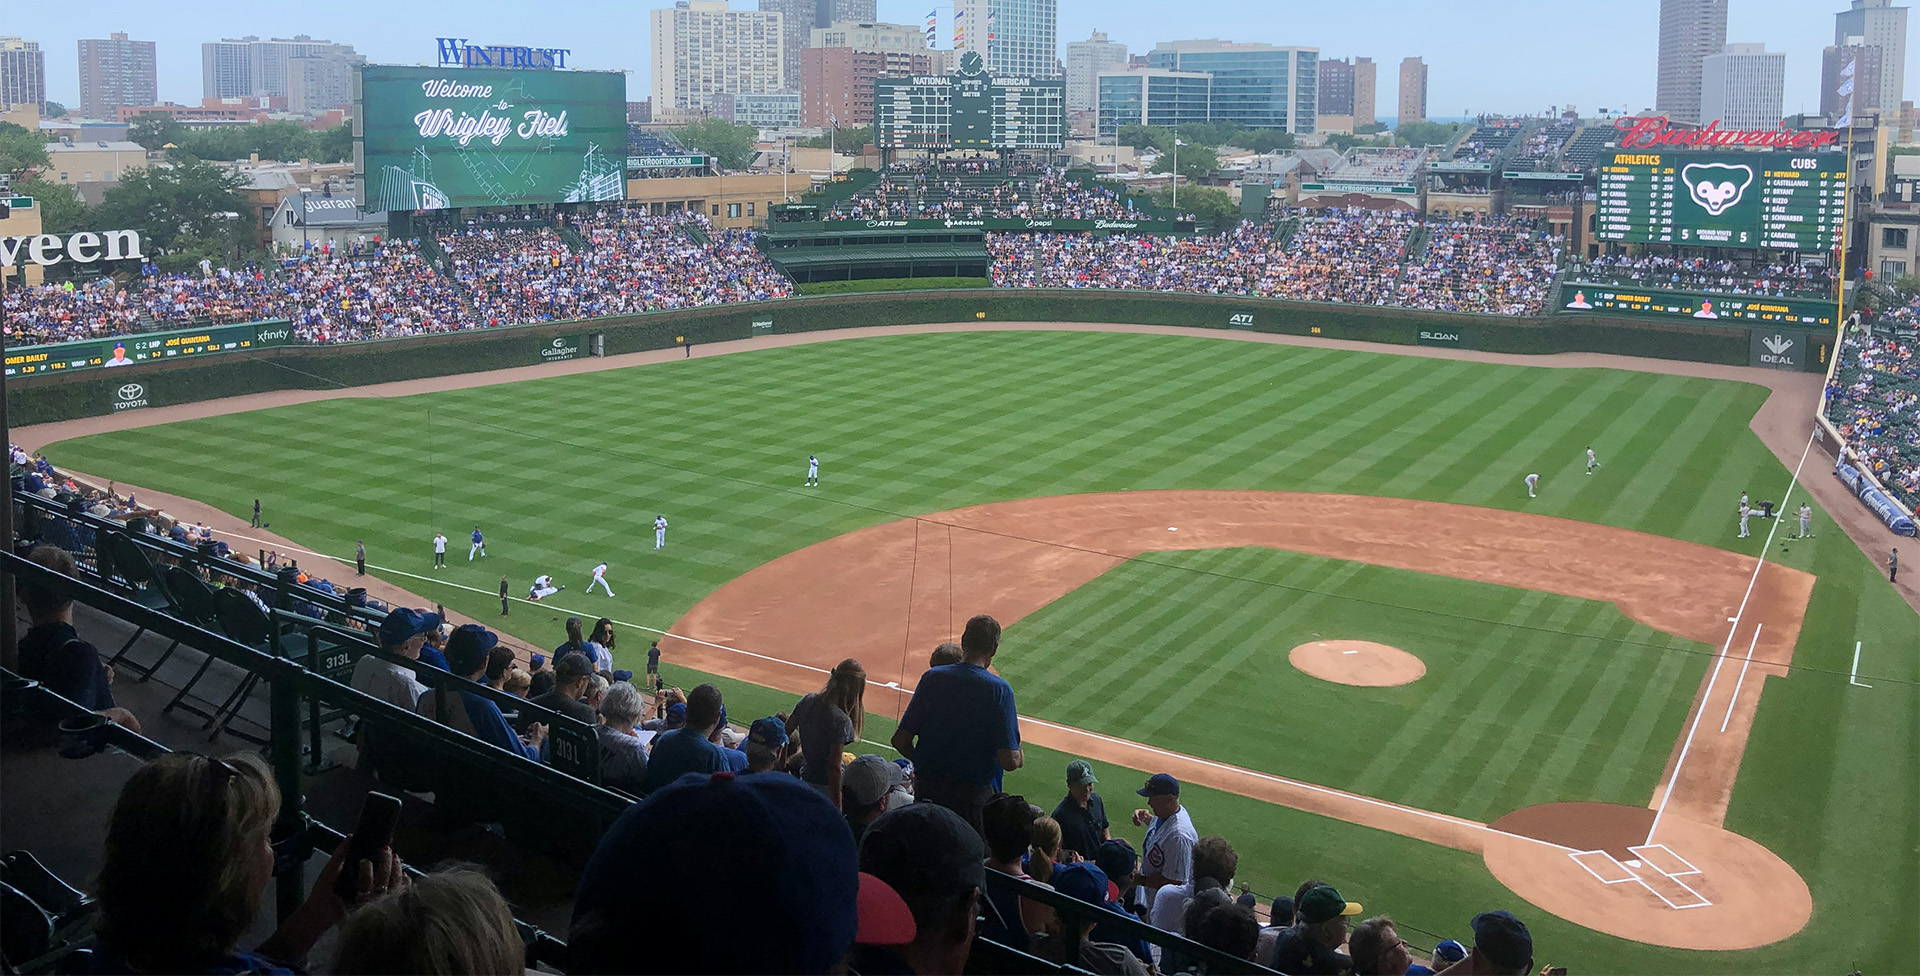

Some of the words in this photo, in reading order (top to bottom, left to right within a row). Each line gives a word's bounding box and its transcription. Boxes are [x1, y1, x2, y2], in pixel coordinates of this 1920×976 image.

[435, 37, 571, 69] WINTRUST
[913, 77, 952, 85] NATIONAL
[991, 78, 1030, 86] AMERICAN
[422, 79, 492, 98] Welcome
[414, 108, 512, 146] Wrigley
[1614, 116, 1838, 148] Budweiser
[1614, 154, 1660, 165] ATHLETICS
[1791, 158, 1817, 169] CUBS
[1324, 184, 1391, 192] WRIGLEYROOFTOPS.COM
[1095, 220, 1138, 228] Budweiser
[1681, 229, 1689, 240] 5
[1739, 231, 1747, 243] 5
[1760, 305, 1789, 313] QUINTANA
[1230, 314, 1253, 323] ATI
[257, 329, 289, 343] xfinity
[1420, 332, 1458, 341] SLOAN
[149, 340, 161, 349] LHP
[165, 337, 180, 347] JOSÉ
[181, 335, 210, 345] QUINTANA
[541, 346, 578, 357] Gallagher
[26, 353, 48, 363] BAILEY
[1760, 354, 1794, 365] IDEAL
[114, 399, 148, 410] TOYOTA
[326, 652, 351, 669] 313L
